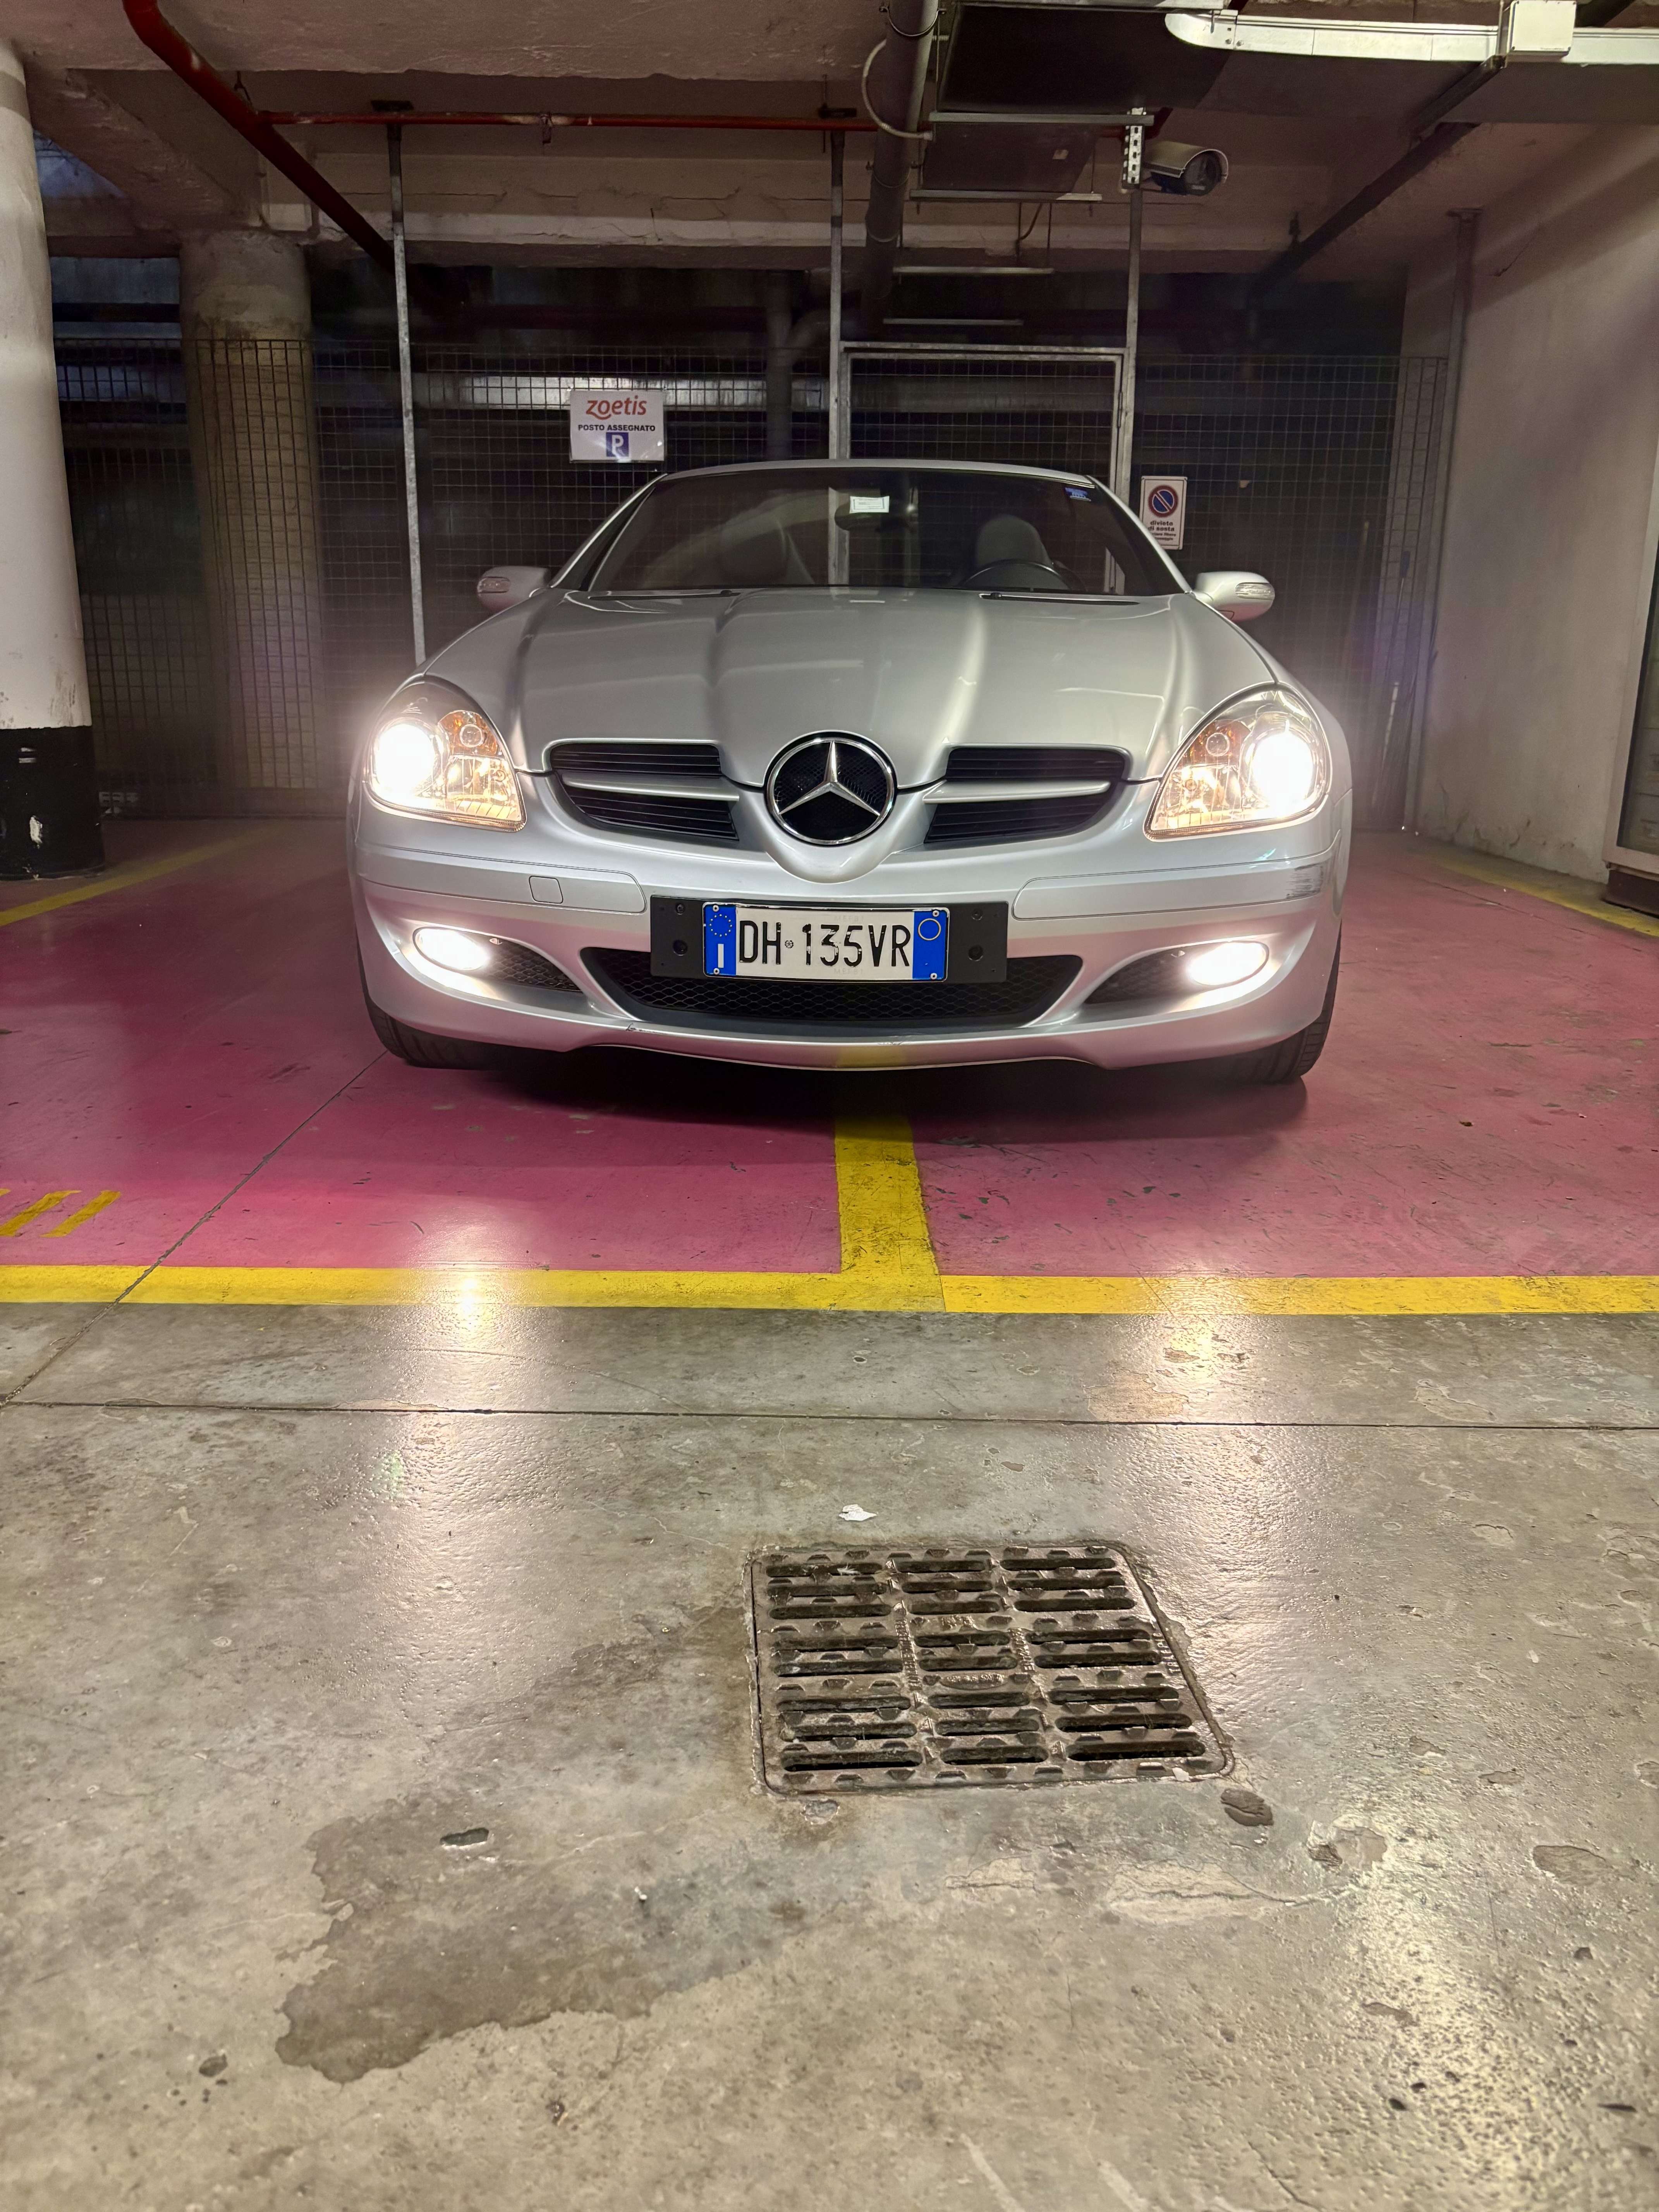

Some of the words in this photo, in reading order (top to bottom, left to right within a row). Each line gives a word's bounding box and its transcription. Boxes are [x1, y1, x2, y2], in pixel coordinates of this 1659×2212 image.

[586, 395, 647, 420] zoetis
[612, 434, 624, 453] P
[739, 920, 781, 964] DH
